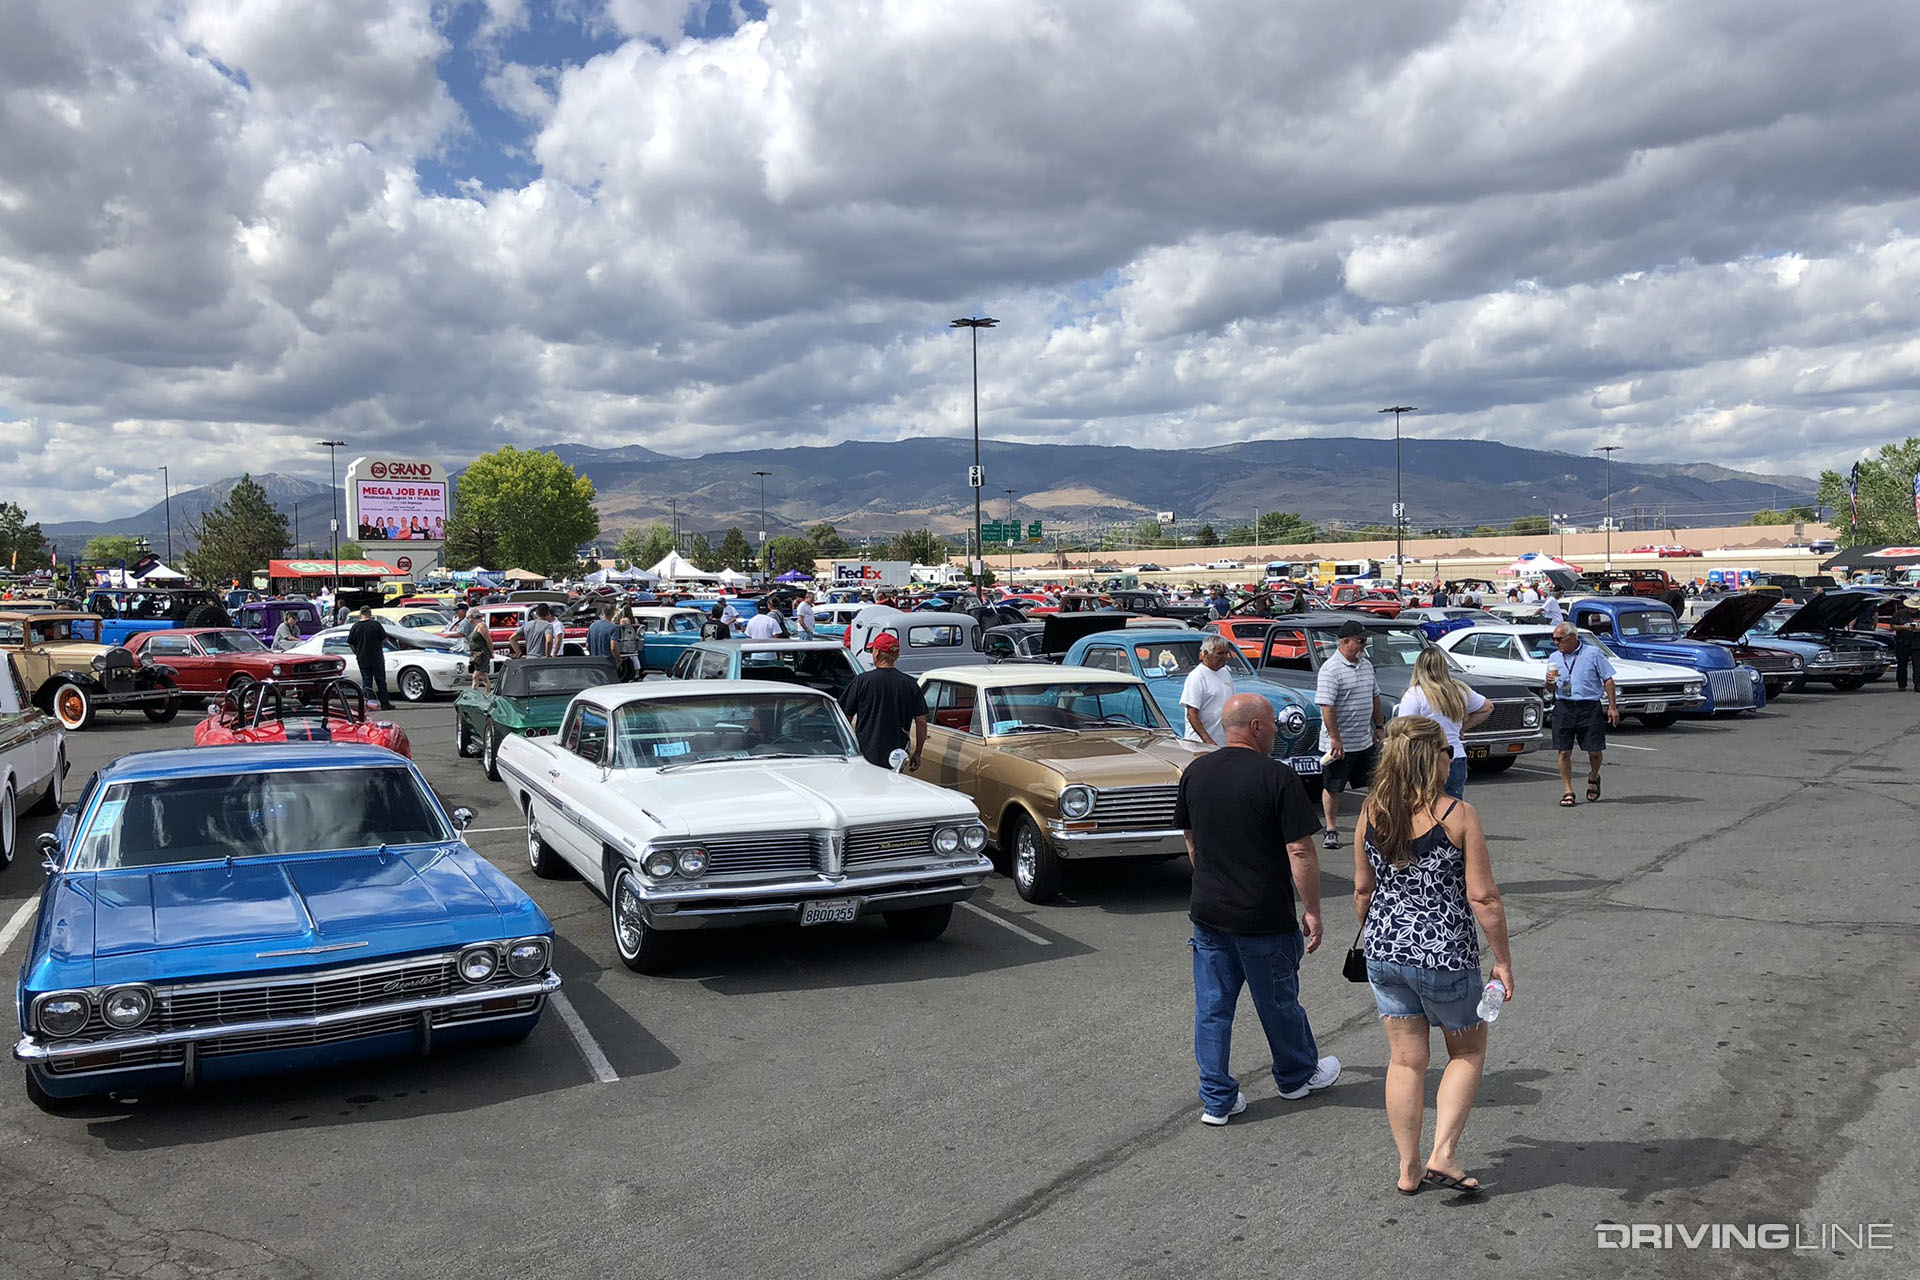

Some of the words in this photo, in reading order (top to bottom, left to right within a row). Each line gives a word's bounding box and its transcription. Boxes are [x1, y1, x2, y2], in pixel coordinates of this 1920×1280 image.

[388, 462, 432, 476] GRAND
[972, 466, 978, 476] 3
[972, 476, 979, 485] H
[362, 487, 393, 495] MEGA
[396, 488, 415, 496] JOB
[418, 488, 440, 496] FAIR
[838, 565, 882, 580] FedEx
[1294, 761, 1319, 772] RATCAR
[382, 975, 438, 992] Chevrolet
